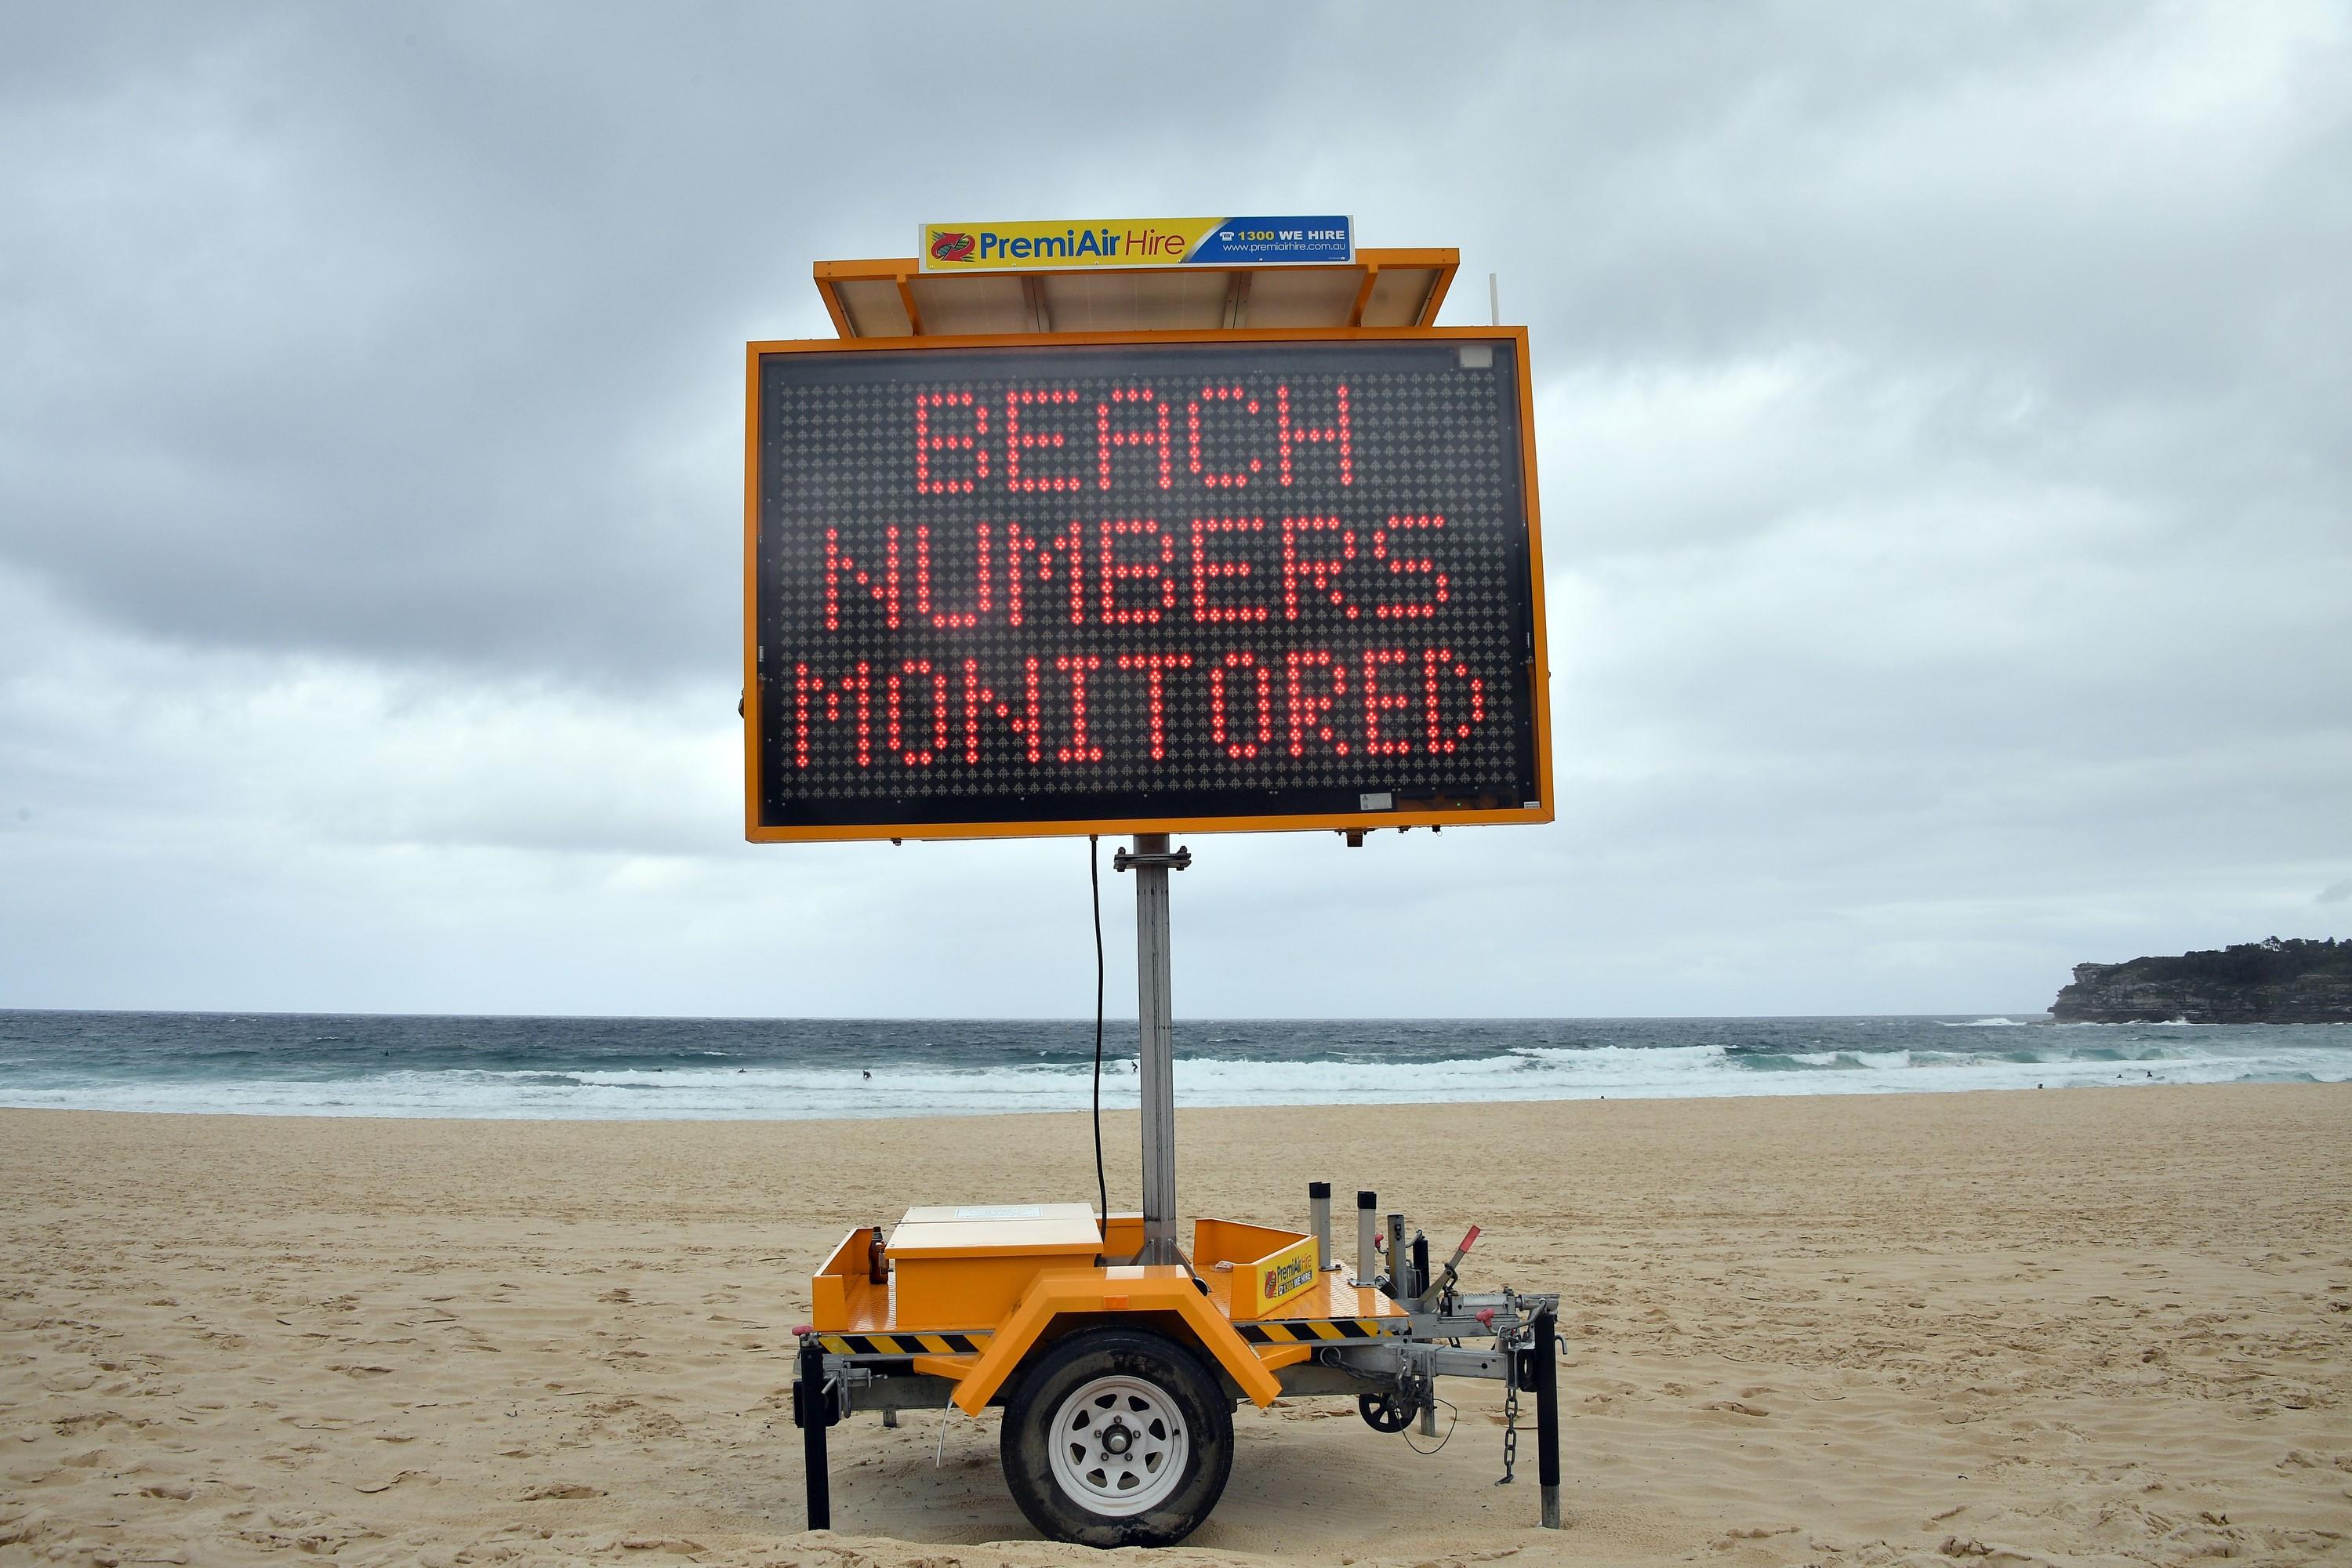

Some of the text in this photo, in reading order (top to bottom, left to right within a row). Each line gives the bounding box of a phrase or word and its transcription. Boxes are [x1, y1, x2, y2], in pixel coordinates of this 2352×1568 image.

[980, 228, 1185, 260] PremiAir Hire
[1222, 241, 1346, 253] www.premiairhire.com.au
[1238, 230, 1345, 241] 1300 WE HIRE
[916, 383, 1354, 494] BEACH
[826, 514, 1449, 630] NUMBERS
[796, 649, 1485, 768] MONITORED
[1276, 1255, 1301, 1283] PremiAir
[1294, 1275, 1301, 1287] WE
